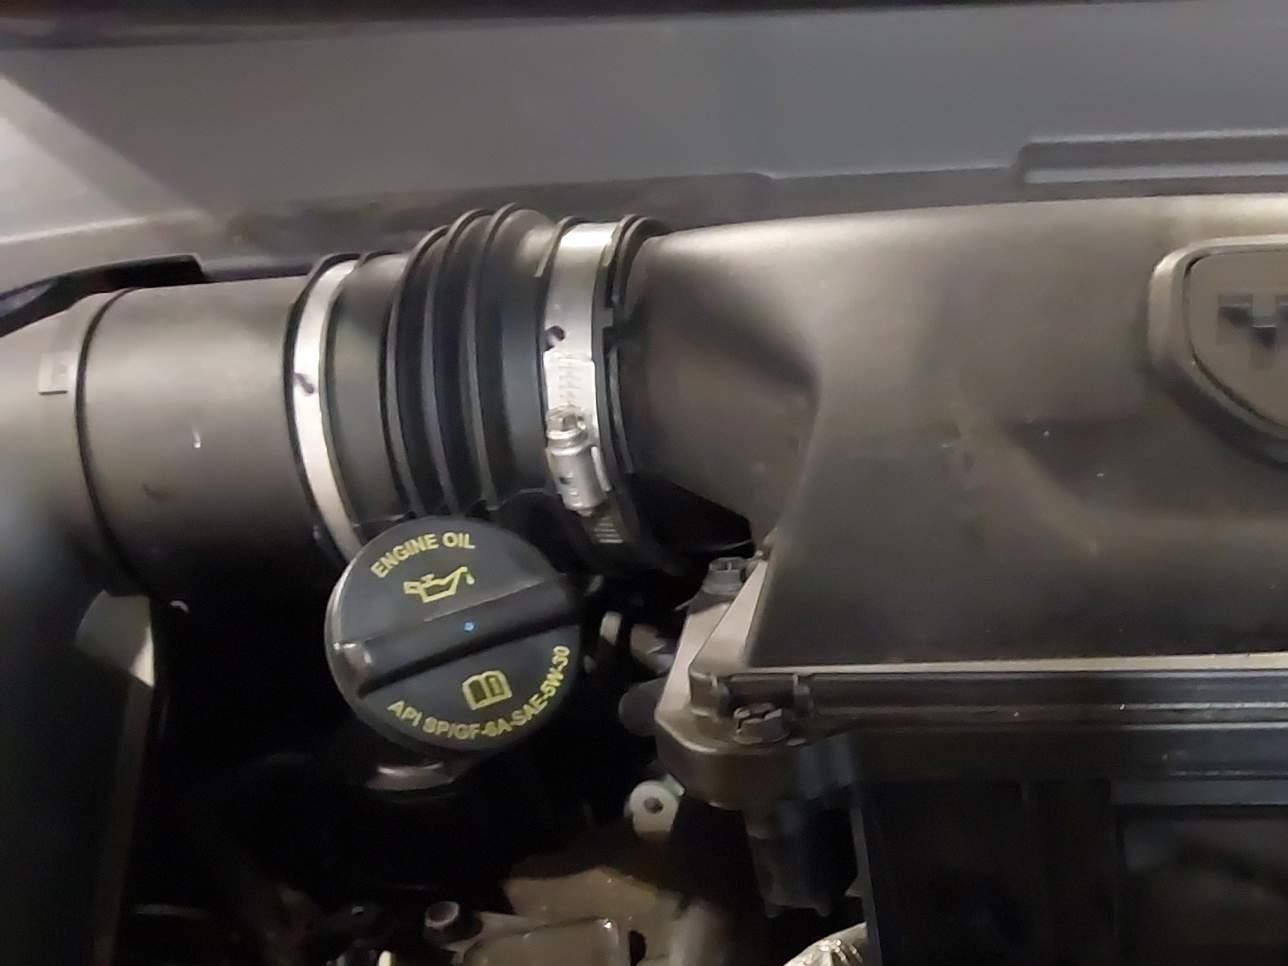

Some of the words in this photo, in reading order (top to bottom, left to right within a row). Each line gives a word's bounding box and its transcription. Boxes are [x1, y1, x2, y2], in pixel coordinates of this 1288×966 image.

[370, 533, 440, 579] ENGINE
[442, 532, 476, 550] OIL
[387, 700, 421, 728] API
